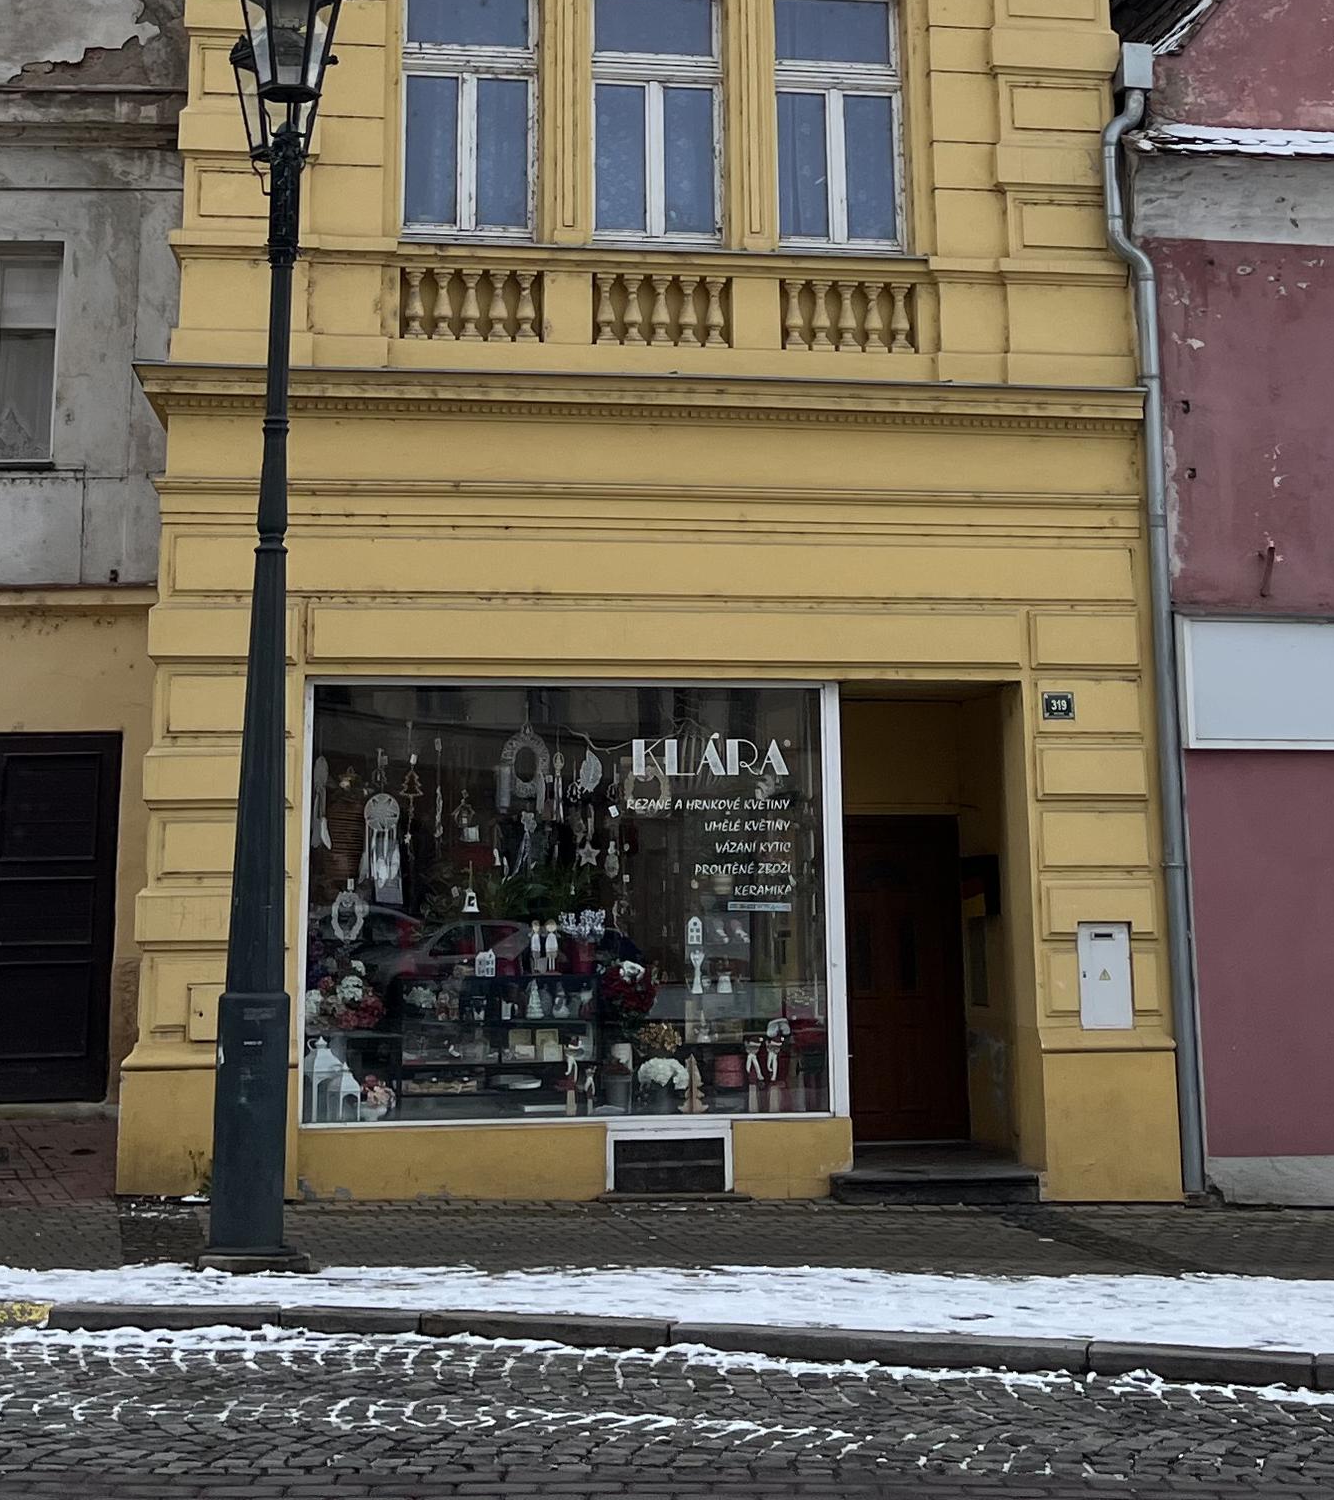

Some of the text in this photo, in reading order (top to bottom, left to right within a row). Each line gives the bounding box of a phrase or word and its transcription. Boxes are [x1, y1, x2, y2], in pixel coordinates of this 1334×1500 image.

[1051, 700, 1067, 711] 319
[632, 732, 790, 776] KLÁRA
[674, 799, 683, 810] A
[686, 797, 741, 810] HRNKOVÉ
[704, 818, 791, 832] UMĚLÉ KVĚTINY
[715, 840, 791, 853] VÁZÁNÍ KYTIC
[733, 884, 792, 896] KERAMIKA
